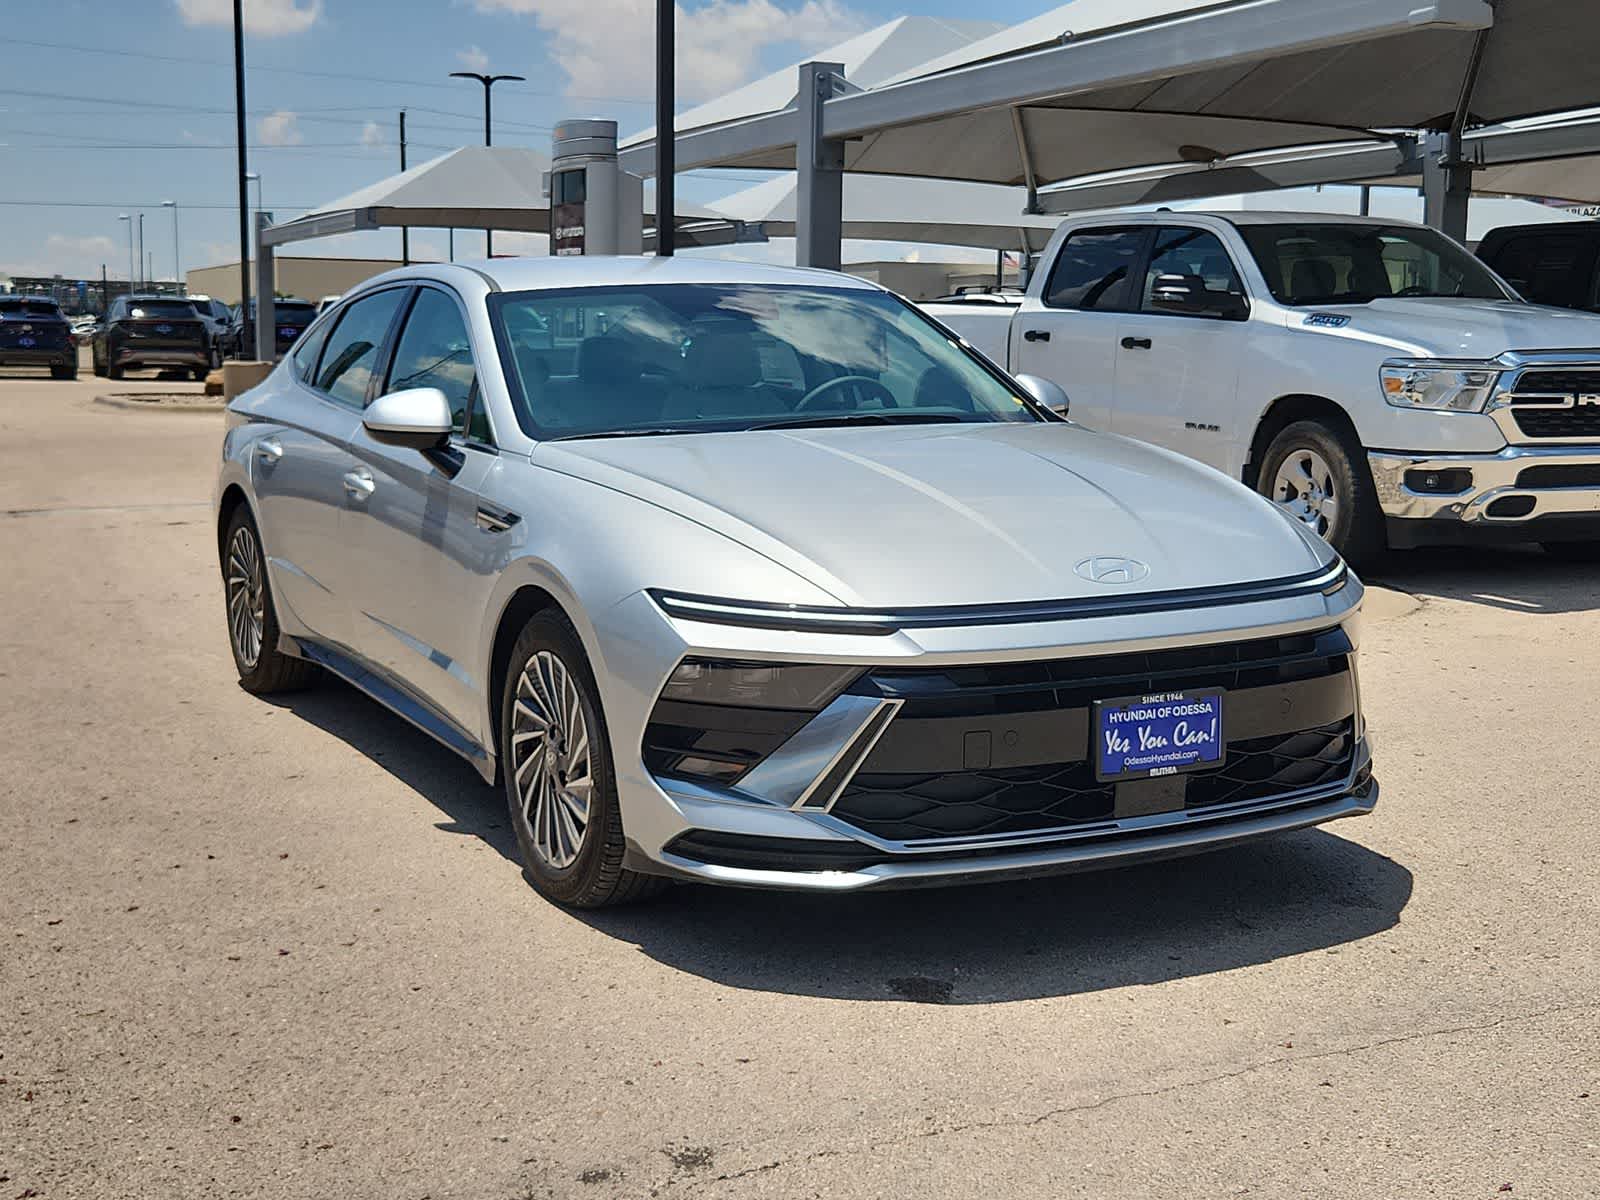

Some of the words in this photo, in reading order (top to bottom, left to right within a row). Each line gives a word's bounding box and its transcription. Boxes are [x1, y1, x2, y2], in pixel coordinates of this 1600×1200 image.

[1142, 695, 1164, 704] SINCE
[1109, 709, 1156, 723] HYUNDAI
[1157, 707, 1171, 718] OF
[1172, 703, 1212, 717] ODESSA
[1105, 729, 1131, 755] Yes
[1138, 725, 1168, 751] You
[1173, 718, 1216, 746] Can!
[1124, 751, 1199, 766] OdessaHyundai.com
